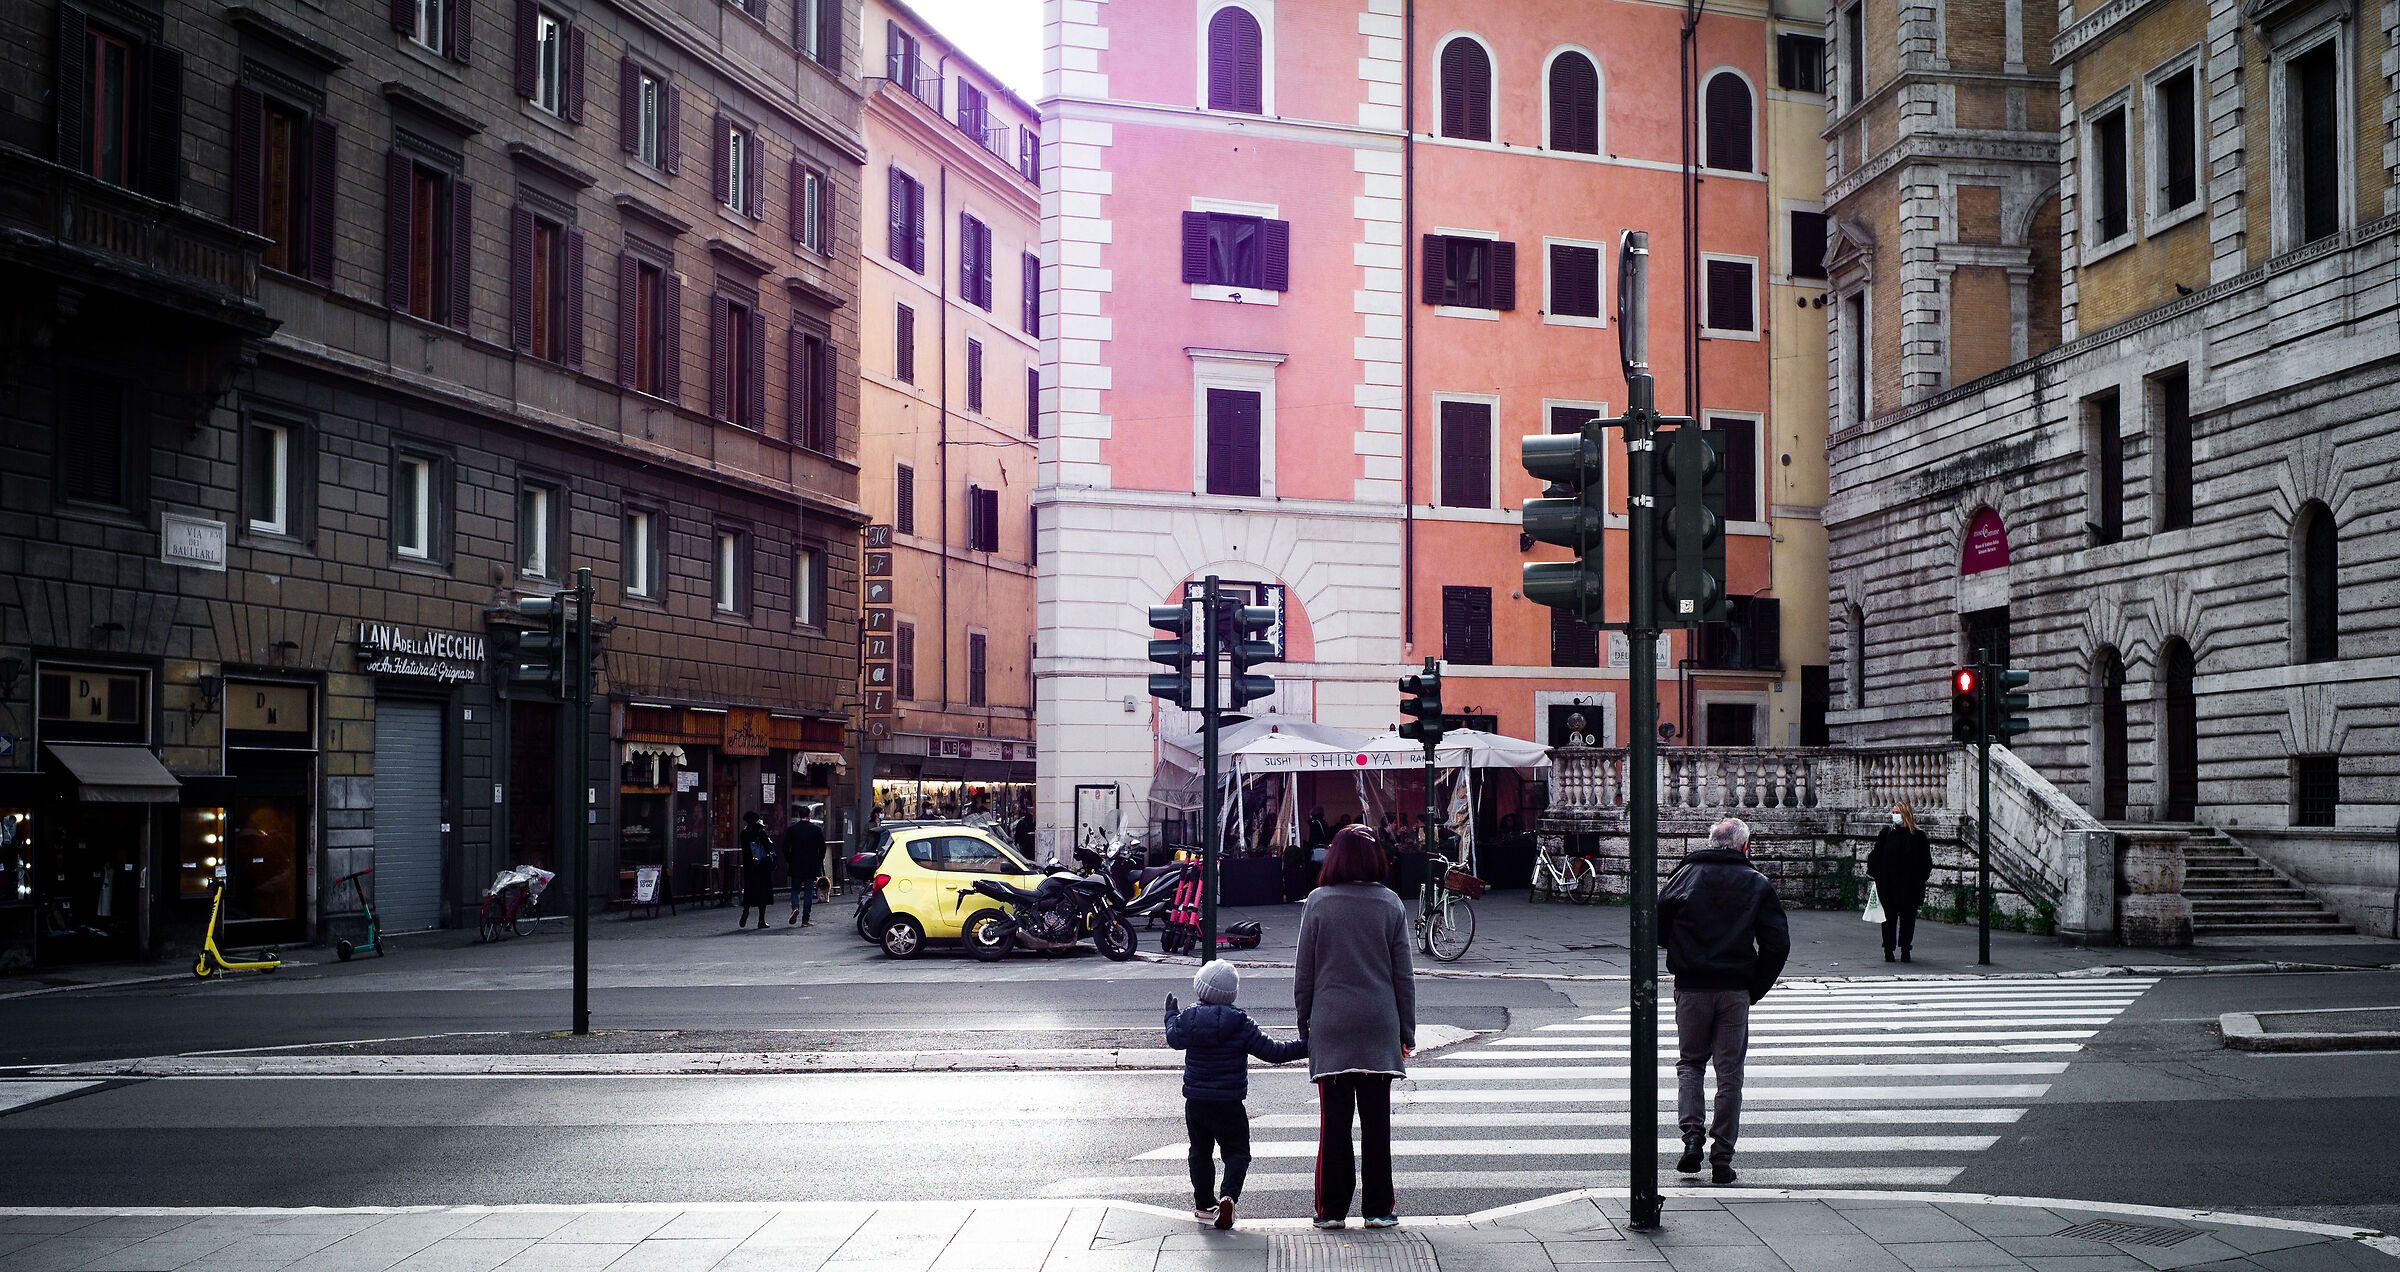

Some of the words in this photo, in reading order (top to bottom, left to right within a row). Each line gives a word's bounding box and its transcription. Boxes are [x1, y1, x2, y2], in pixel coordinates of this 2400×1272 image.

[187, 527, 202, 540] VIA
[868, 526, 888, 546] Il
[172, 545, 214, 560] BAULLARI
[360, 622, 402, 652] LANA
[401, 639, 429, 656] DELLA
[428, 631, 485, 661] VECCHIA
[79, 680, 90, 698] D
[91, 697, 102, 716] M
[256, 692, 266, 709] D
[267, 707, 278, 724] M
[1264, 757, 1291, 766] SUSHI
[1310, 753, 1393, 768] SHIROYA
[1410, 754, 1442, 763] RAN
